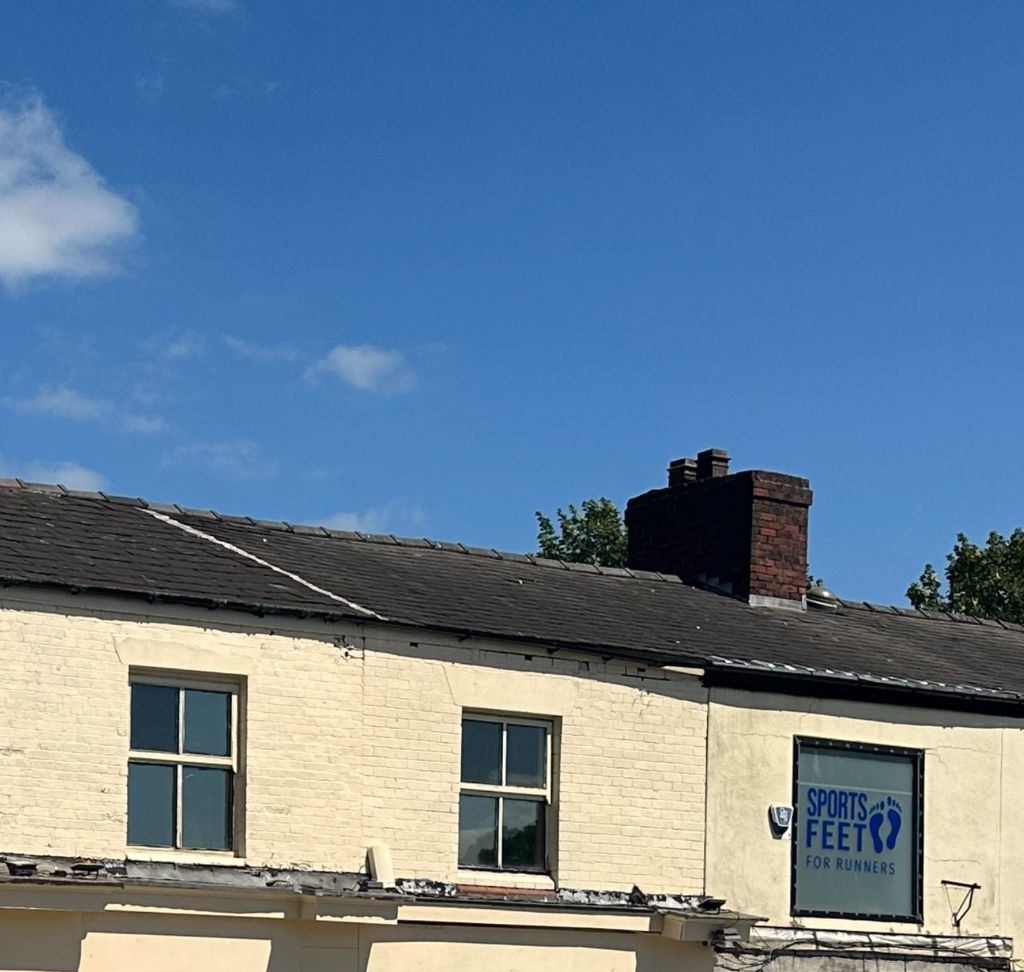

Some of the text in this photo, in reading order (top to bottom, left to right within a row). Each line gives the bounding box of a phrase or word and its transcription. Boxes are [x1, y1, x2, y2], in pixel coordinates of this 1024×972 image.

[807, 787, 868, 821] SPORTS
[806, 819, 867, 852] FEET
[806, 855, 896, 876] FOR RUNNERS
